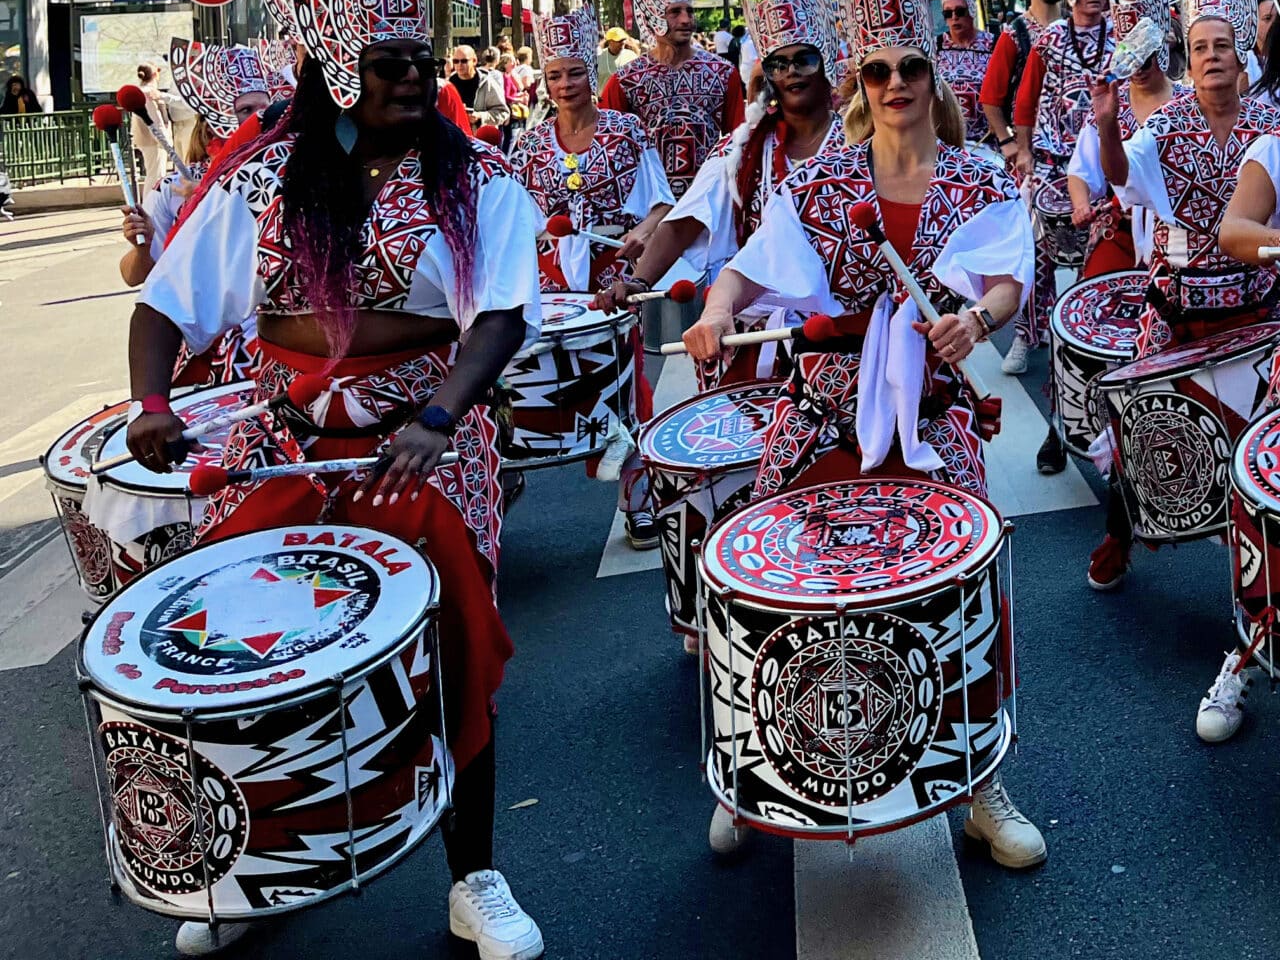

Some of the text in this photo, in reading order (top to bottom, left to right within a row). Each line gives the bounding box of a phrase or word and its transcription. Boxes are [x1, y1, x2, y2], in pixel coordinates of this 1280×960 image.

[1124, 397, 1190, 427] BATALA
[695, 447, 765, 463] GENEV
[784, 486, 932, 511] BATALA
[1156, 502, 1213, 528] MUNDO
[282, 531, 412, 577] BATALA
[277, 553, 369, 587] BRASIL
[785, 620, 895, 651] BATALA
[156, 639, 235, 667] FRANCE
[105, 730, 189, 767] BATALA
[130, 858, 196, 886] MUNDO
